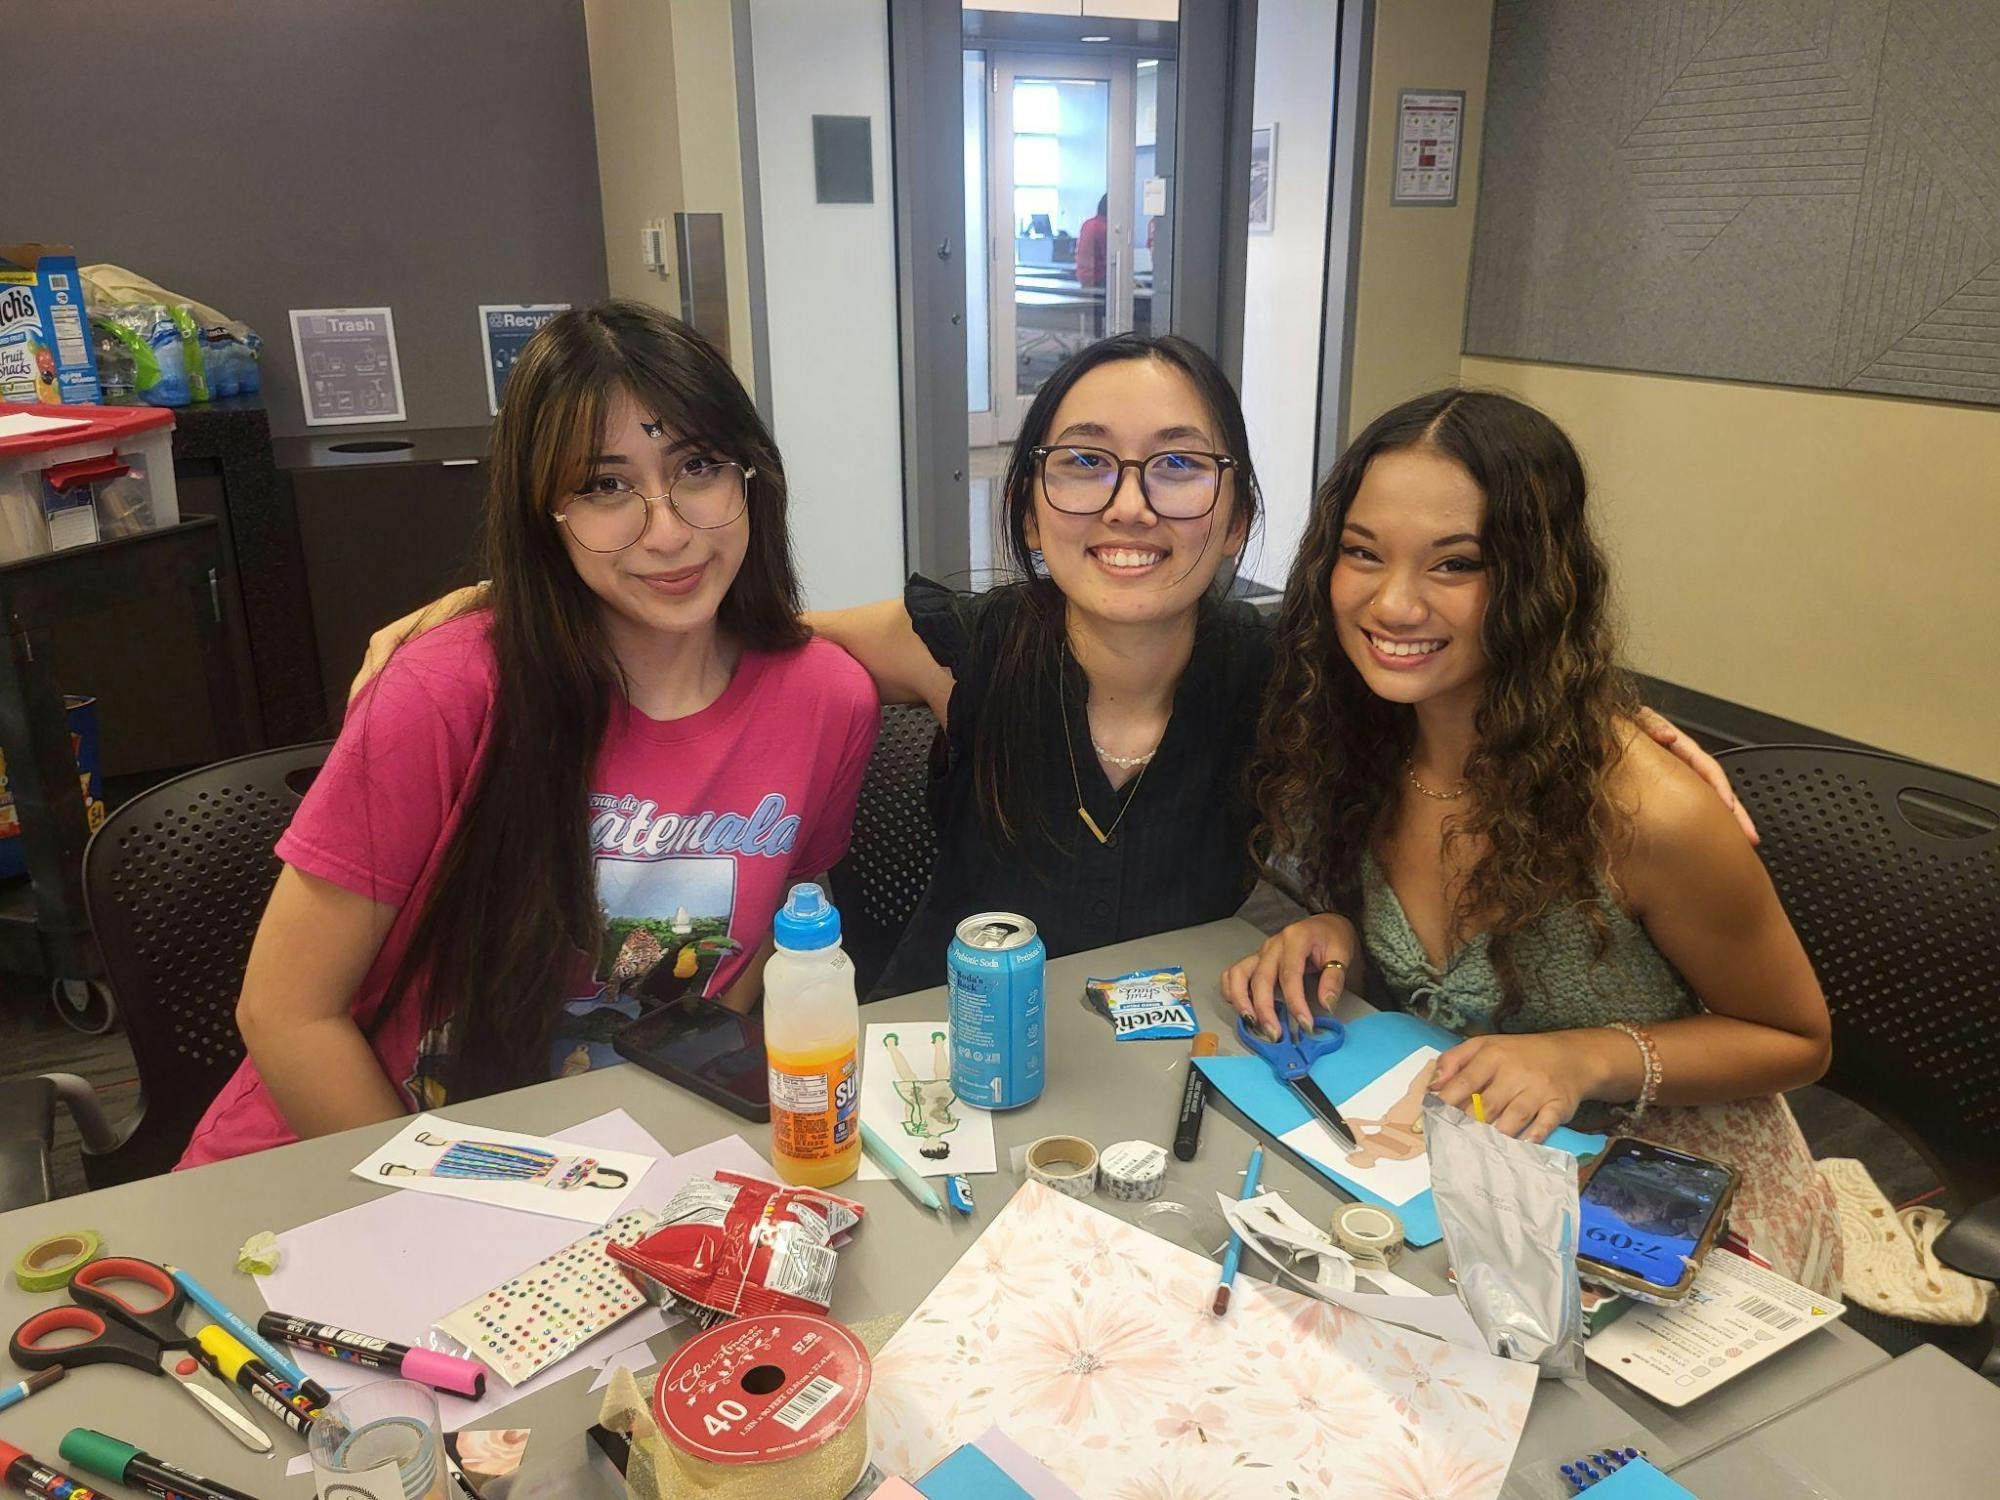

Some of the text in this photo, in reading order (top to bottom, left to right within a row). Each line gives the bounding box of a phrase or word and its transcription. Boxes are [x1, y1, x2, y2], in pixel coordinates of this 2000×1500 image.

[0, 290, 35, 327] ch's
[327, 318, 376, 332] Trash
[1, 350, 24, 365] Fruit
[620, 796, 638, 811] de
[592, 793, 801, 857] atemala
[953, 949, 999, 968] Prebiotic Soda
[1126, 991, 1153, 1001] Fruit
[1585, 1226, 1662, 1261] 7:09
[792, 1332, 817, 1354] $7.99
[668, 1325, 759, 1392] Christmas
[703, 1399, 748, 1437] 40
